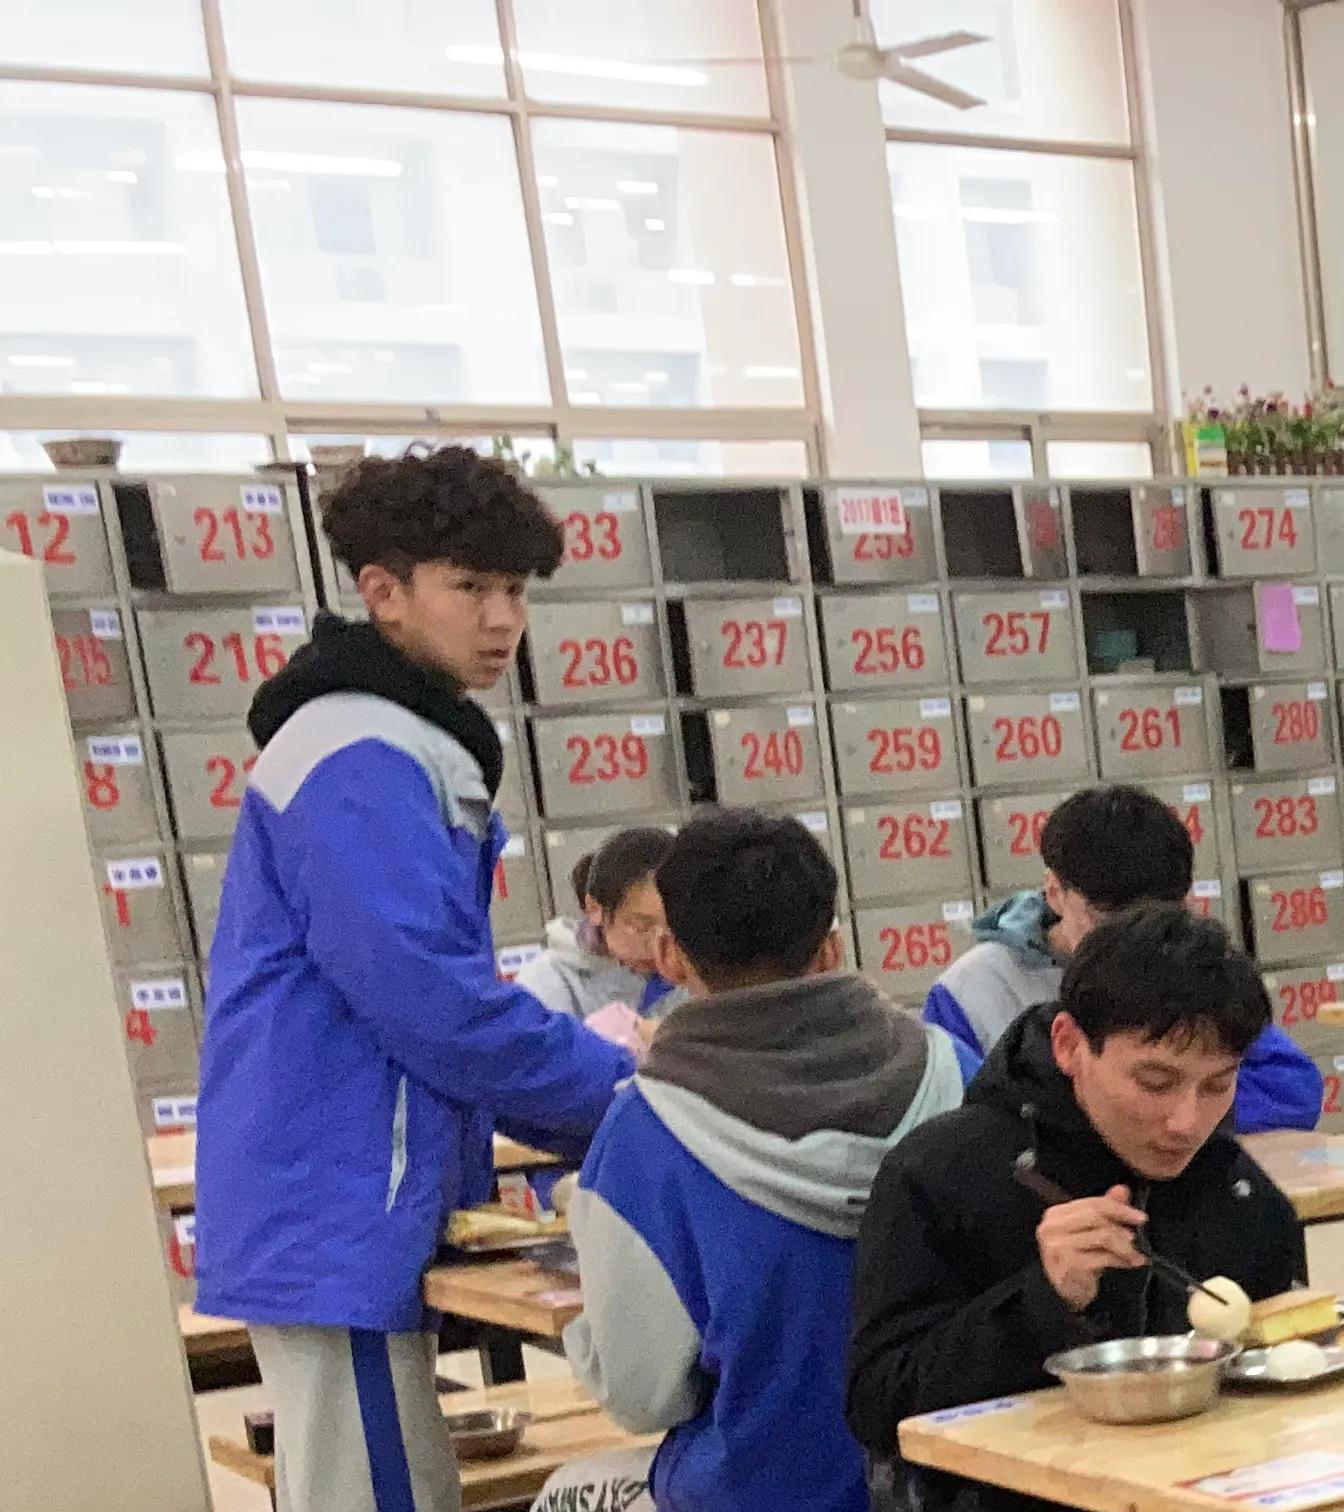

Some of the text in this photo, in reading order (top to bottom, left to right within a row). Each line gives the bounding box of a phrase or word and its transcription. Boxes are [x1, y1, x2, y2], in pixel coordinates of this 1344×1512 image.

[193, 508, 274, 562] 213
[561, 512, 623, 561] 33
[1239, 508, 1297, 550] 274
[721, 620, 787, 668] 237
[851, 627, 925, 674] 256
[982, 611, 1051, 657] 257
[186, 633, 287, 684] 216
[559, 637, 639, 689] 236
[993, 715, 1061, 762] 260
[1119, 706, 1181, 752] 261
[1271, 699, 1322, 746] 280
[567, 734, 649, 784] 239
[740, 729, 803, 780] 240
[868, 728, 941, 772] 259
[879, 815, 948, 859] 262
[1255, 796, 1317, 838] 283
[880, 925, 951, 970] 265
